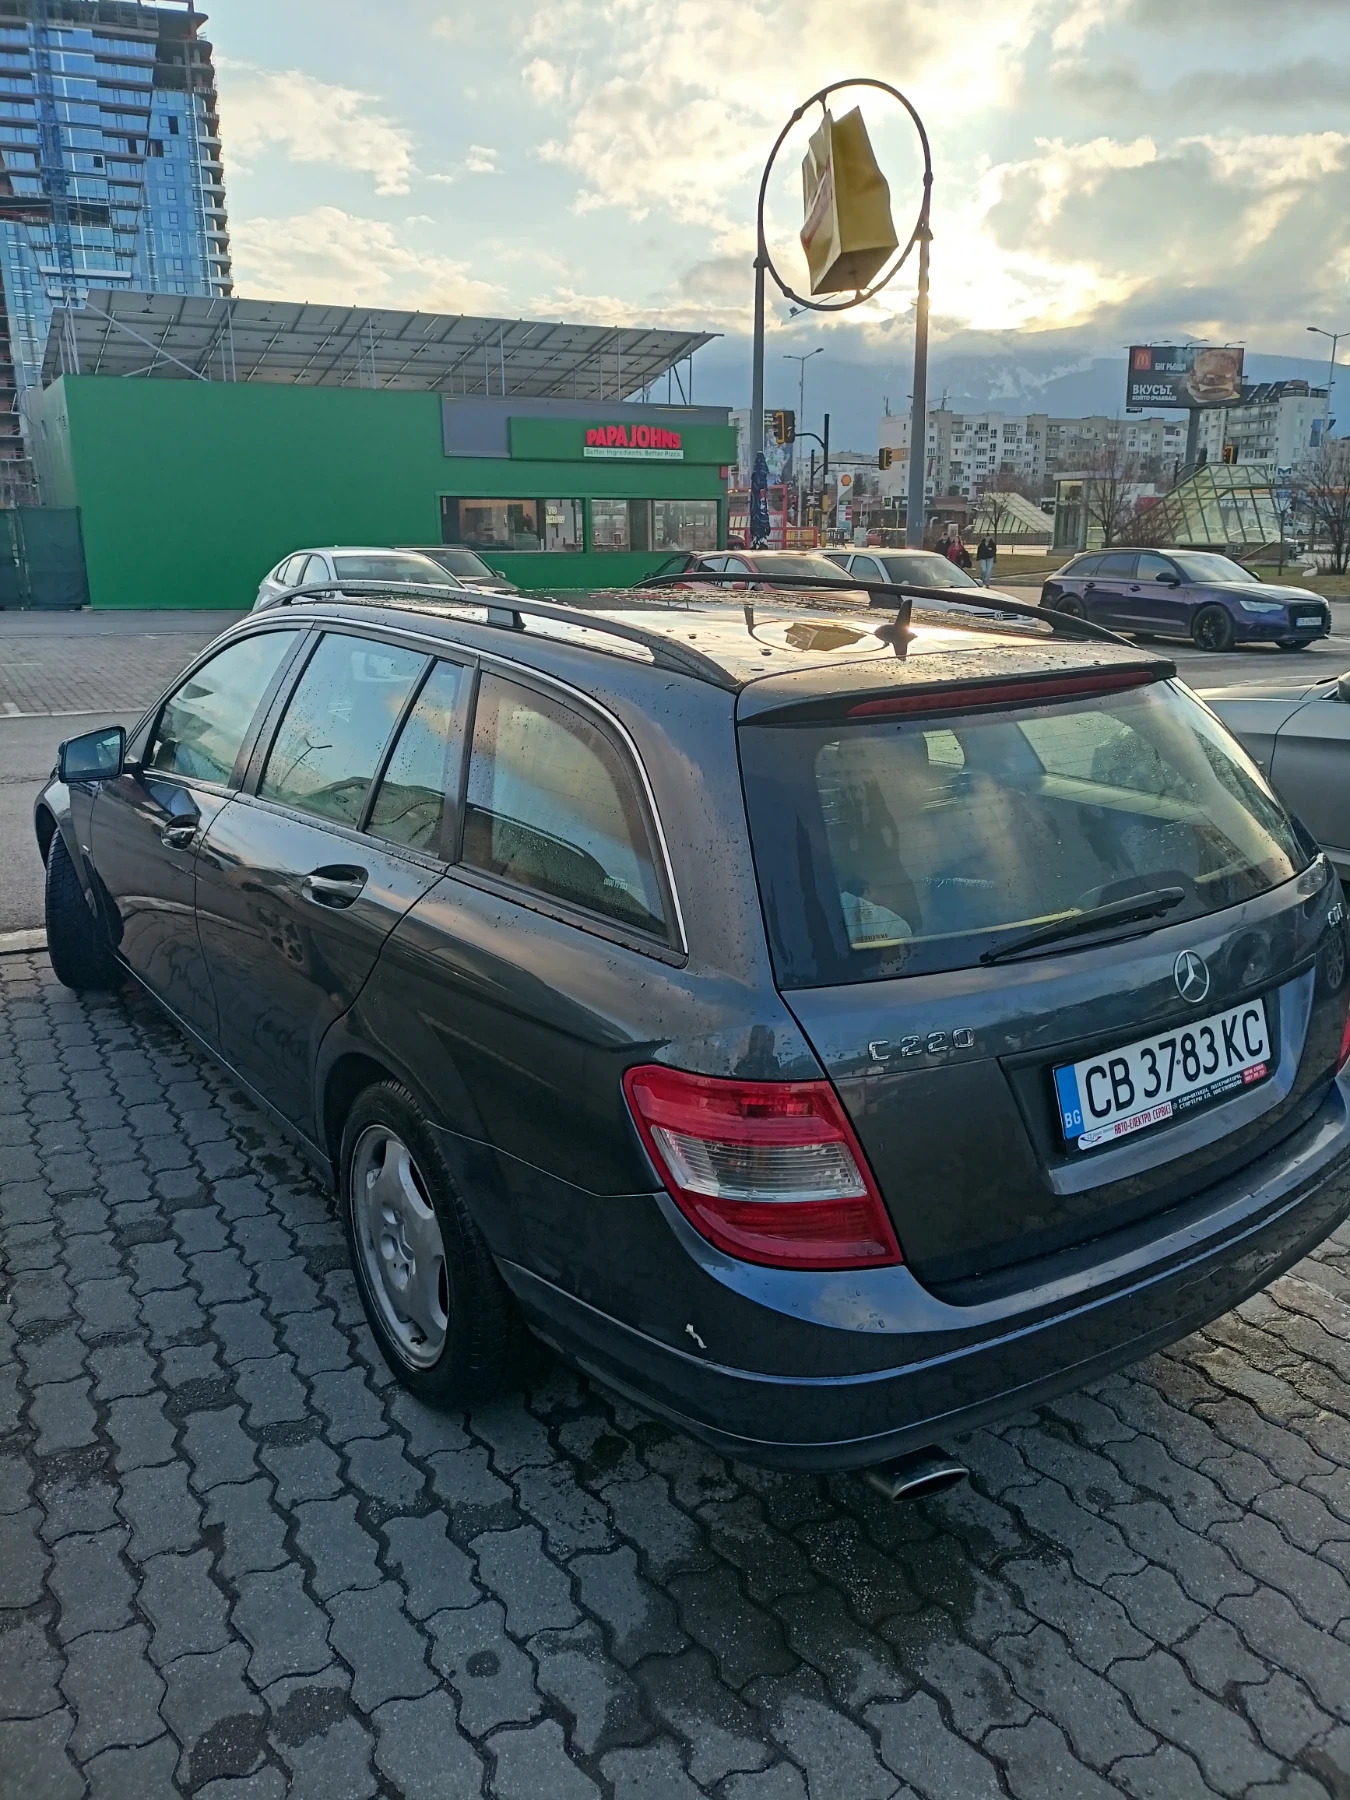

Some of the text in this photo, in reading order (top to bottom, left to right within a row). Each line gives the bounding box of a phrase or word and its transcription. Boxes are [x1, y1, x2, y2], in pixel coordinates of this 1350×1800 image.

[1132, 384, 1172, 396] ВКУСЪТ,
[586, 425, 681, 449] PAPA JOHNS
[868, 1027, 975, 1061] C 220
[1064, 1109, 1082, 1128] BG
[1114, 1112, 1152, 1135] АВТО-ЕЛЕКТРО
[1152, 1103, 1172, 1120] СЕРВИЗ
